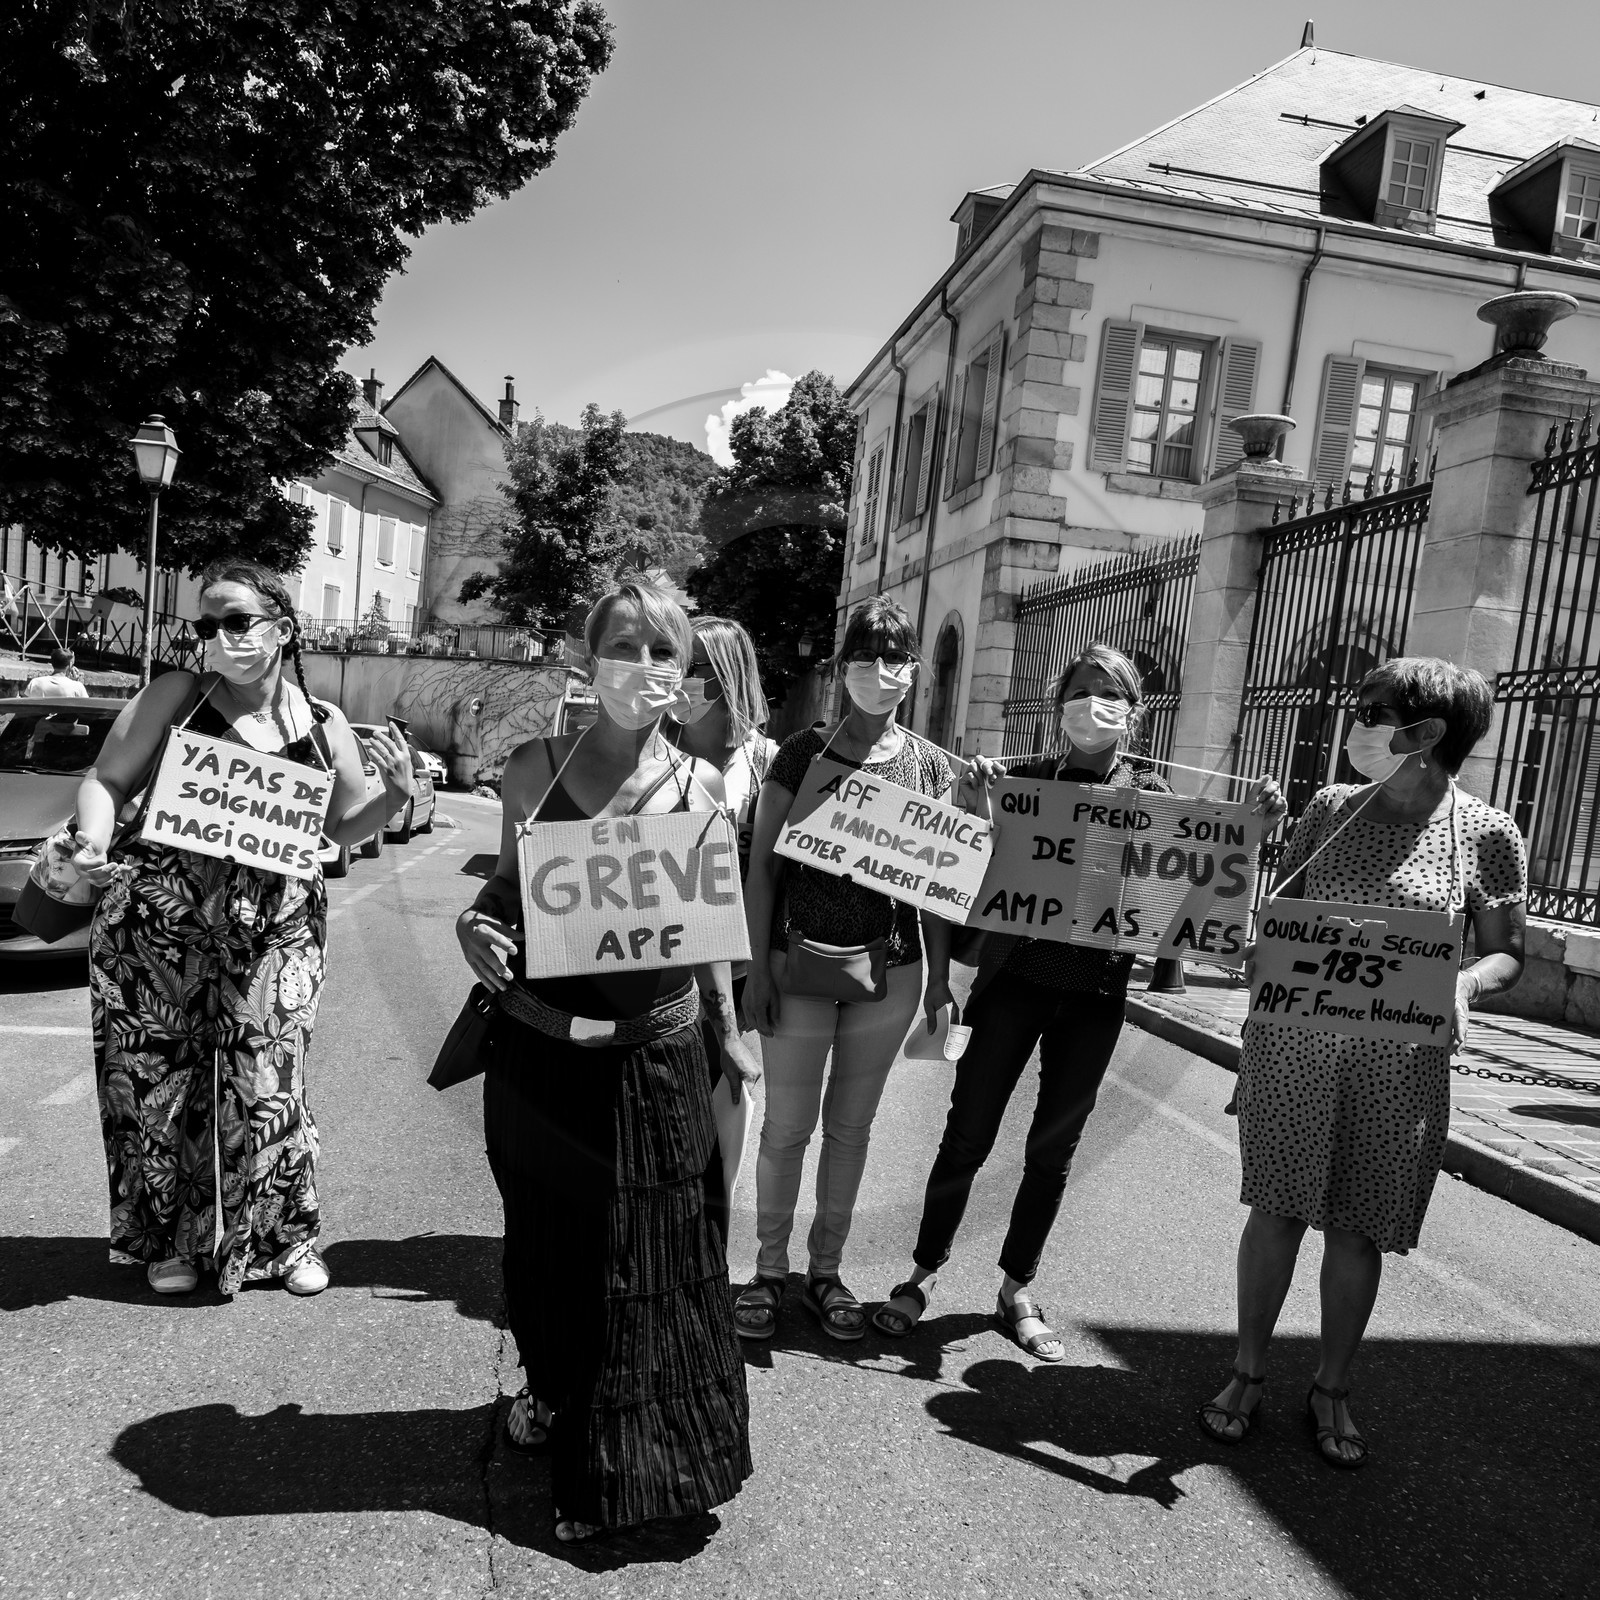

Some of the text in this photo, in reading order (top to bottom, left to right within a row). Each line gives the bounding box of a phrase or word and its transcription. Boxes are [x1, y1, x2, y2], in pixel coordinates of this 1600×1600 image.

[228, 759, 285, 794] PAS
[292, 780, 327, 806] DE
[591, 818, 640, 845] EN
[817, 775, 988, 852] APF FRANCE
[1073, 803, 1152, 831] PREND
[830, 811, 960, 869] HANDICAP
[531, 841, 737, 916] GREVE
[785, 830, 847, 864] FOYER
[853, 856, 925, 891] ALBERT
[925, 881, 975, 910] BOREL
[1032, 835, 1250, 899] DE NOUS
[596, 923, 684, 960] APF
[1172, 917, 1243, 955] AES
[1349, 930, 1371, 949] du
[1370, 998, 1446, 1035] Handicap
